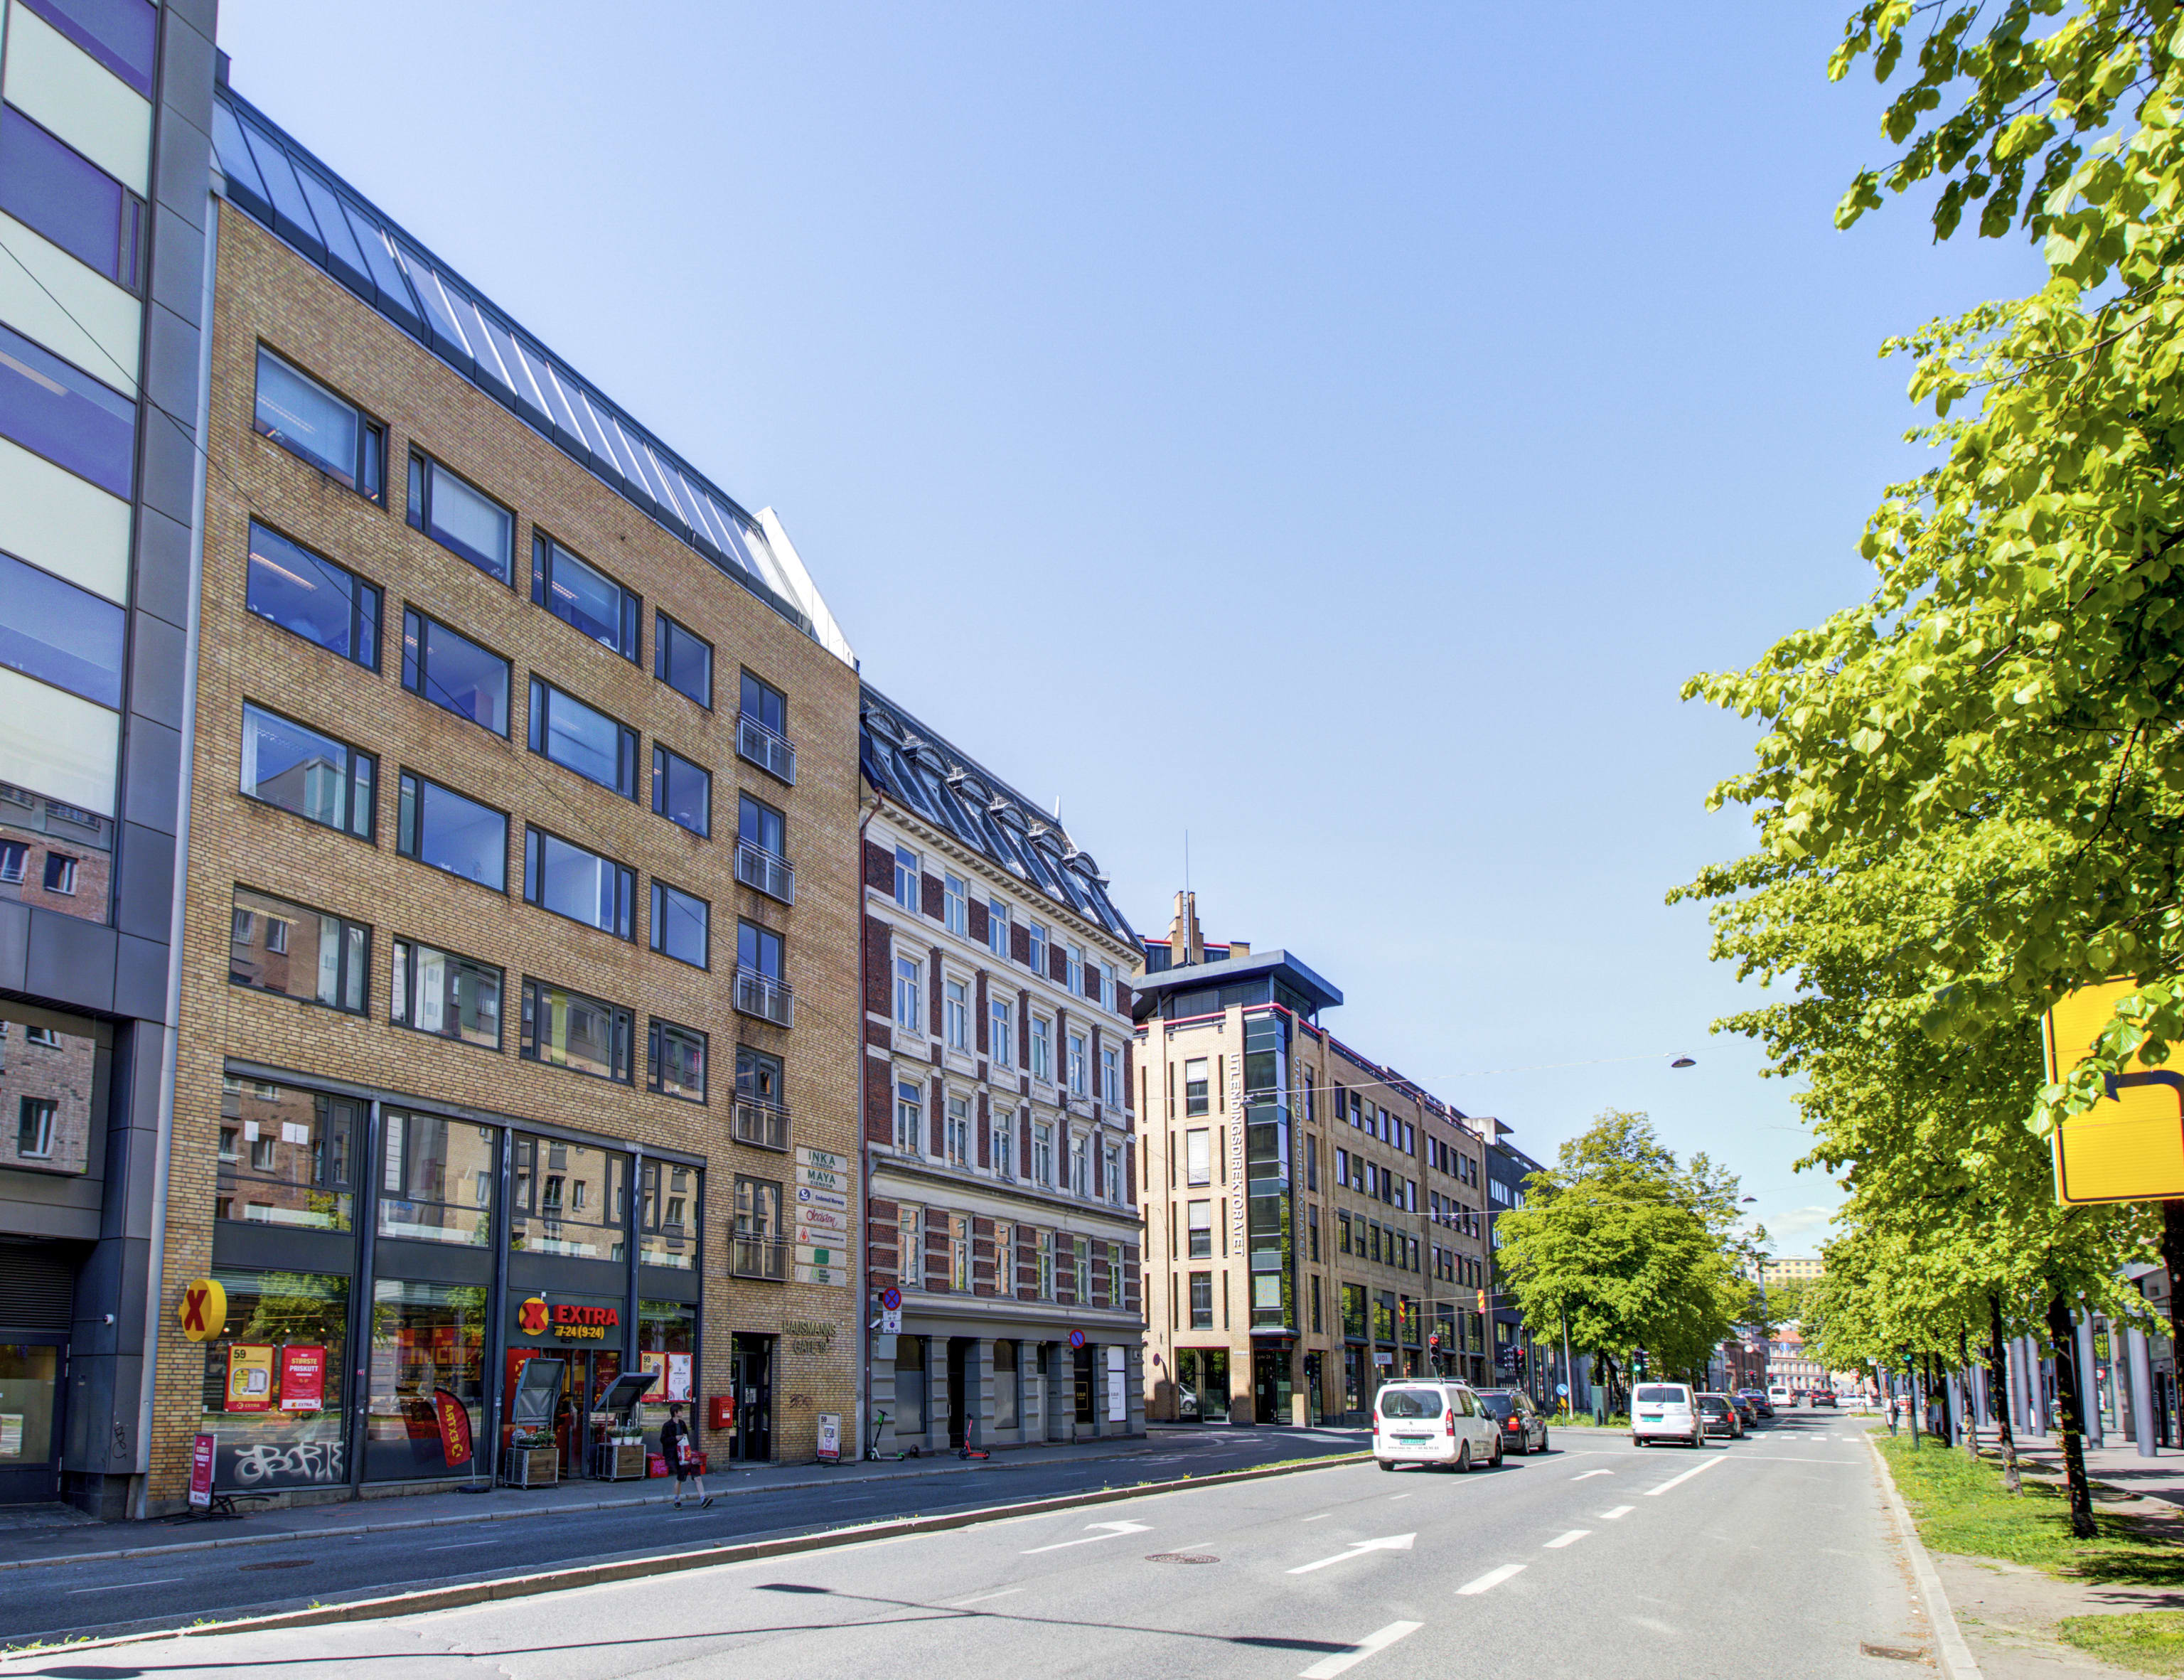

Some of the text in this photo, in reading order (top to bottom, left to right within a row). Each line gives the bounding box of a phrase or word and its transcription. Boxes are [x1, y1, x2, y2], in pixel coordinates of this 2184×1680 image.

[808, 1150, 836, 1165] INKA
[1228, 1053, 1245, 1257] UTLENDINGSDIREKTORATET
[808, 1169, 836, 1184] MAYA
[553, 1305, 619, 1326] EXTRA
[578, 1325, 604, 1339] (9-24)
[783, 1319, 837, 1337] HAUSMANNS
[233, 1349, 246, 1359] 59
[793, 1339, 815, 1354] GATE
